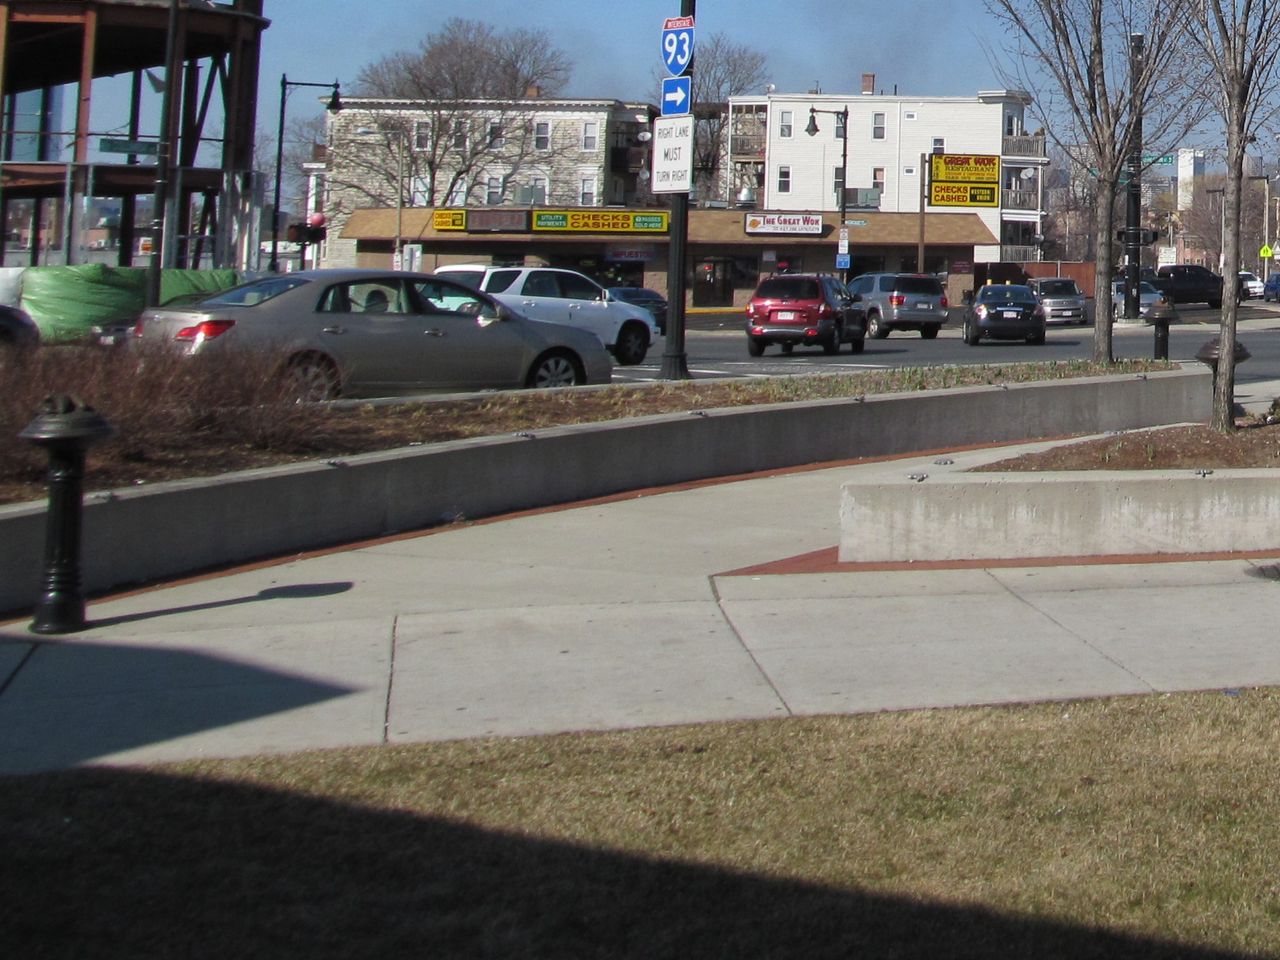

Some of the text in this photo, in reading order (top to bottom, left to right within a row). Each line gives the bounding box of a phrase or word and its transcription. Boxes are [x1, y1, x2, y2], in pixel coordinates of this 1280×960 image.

[665, 32, 690, 65] 93
[658, 126, 689, 139] RIGHT LANE
[663, 147, 681, 161] MUST
[944, 157, 996, 167] GREAT WOK
[656, 169, 688, 182] TURN RIGHT
[571, 221, 631, 229] CASHED
[762, 216, 819, 225] THE GREAT WOK
